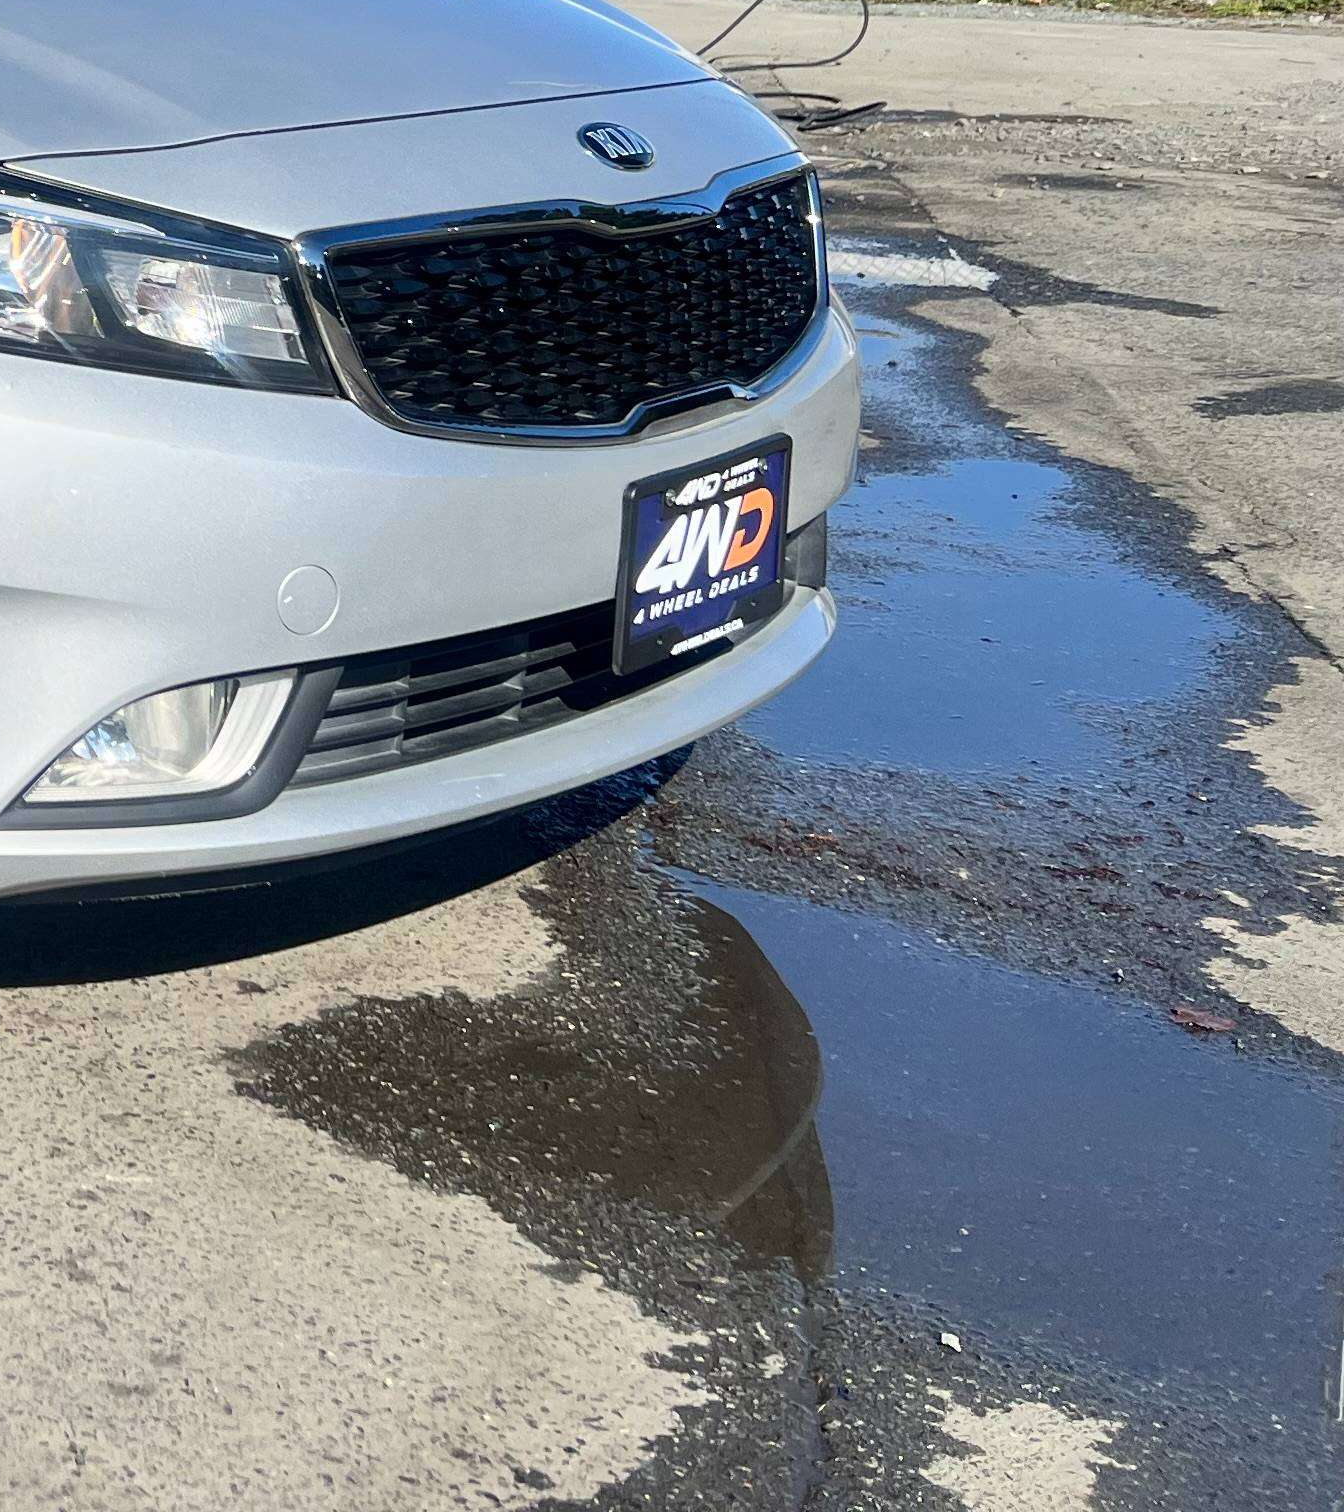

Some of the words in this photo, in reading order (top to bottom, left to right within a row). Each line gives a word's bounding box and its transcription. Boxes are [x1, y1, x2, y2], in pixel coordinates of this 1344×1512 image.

[585, 126, 653, 159] KIA
[635, 487, 775, 594] 4WD
[633, 608, 645, 625] 4
[649, 588, 703, 620] WHEEL
[708, 565, 759, 599] DEALS
